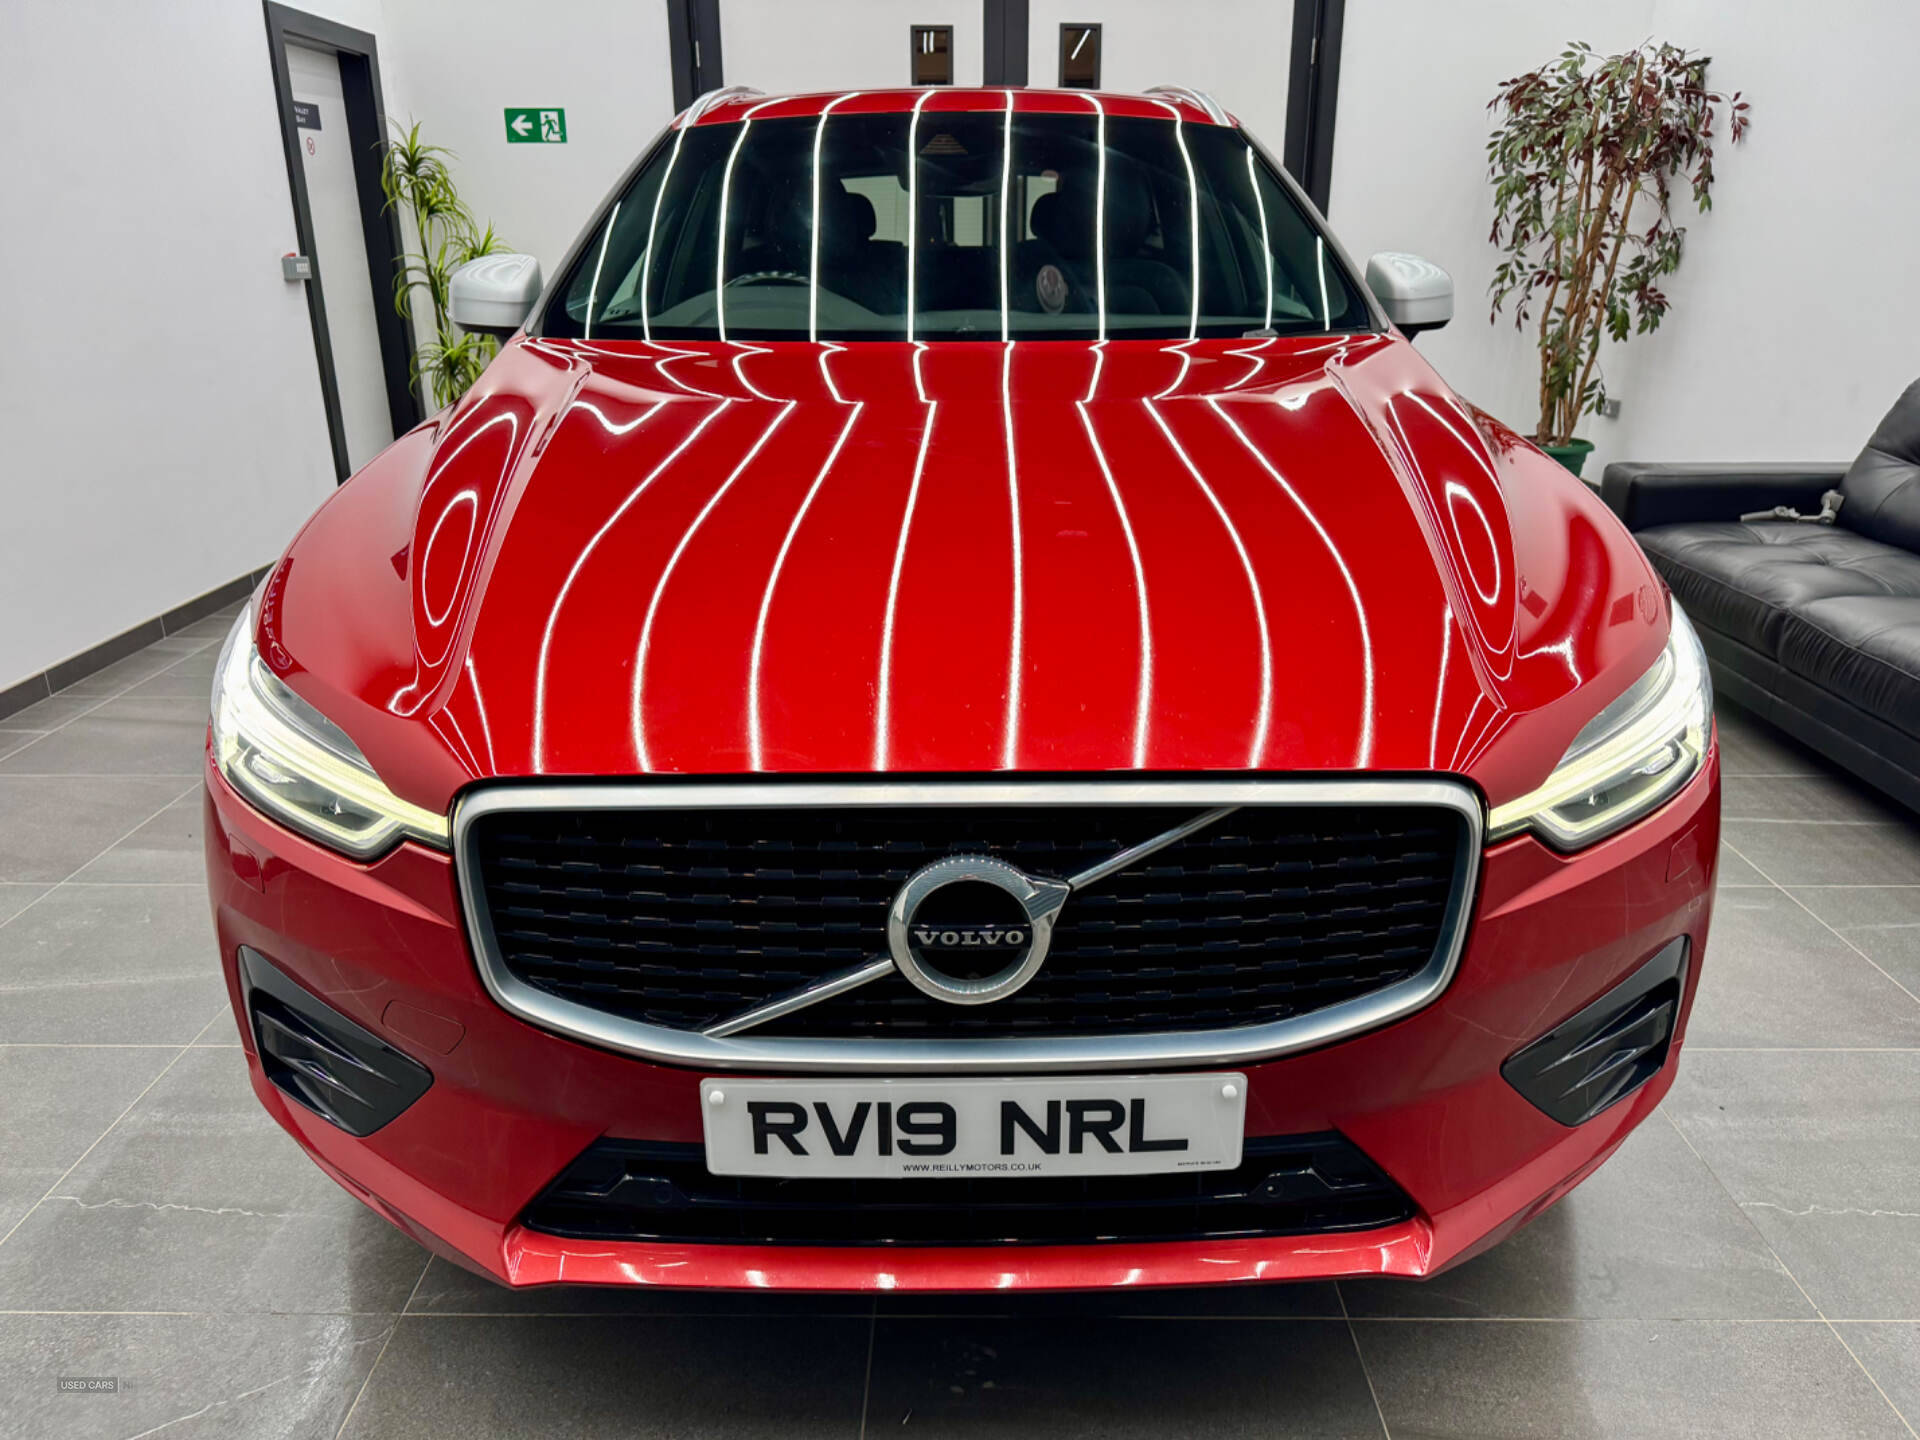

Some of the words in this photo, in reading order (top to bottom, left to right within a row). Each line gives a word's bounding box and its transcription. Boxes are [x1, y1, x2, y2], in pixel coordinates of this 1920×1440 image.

[914, 931, 1024, 945] VOLVO
[747, 1100, 957, 1157] RV19
[1000, 1098, 1189, 1156] NRL
[902, 1162, 1042, 1172] WWW.REILLYMOTORS.CO.UK
